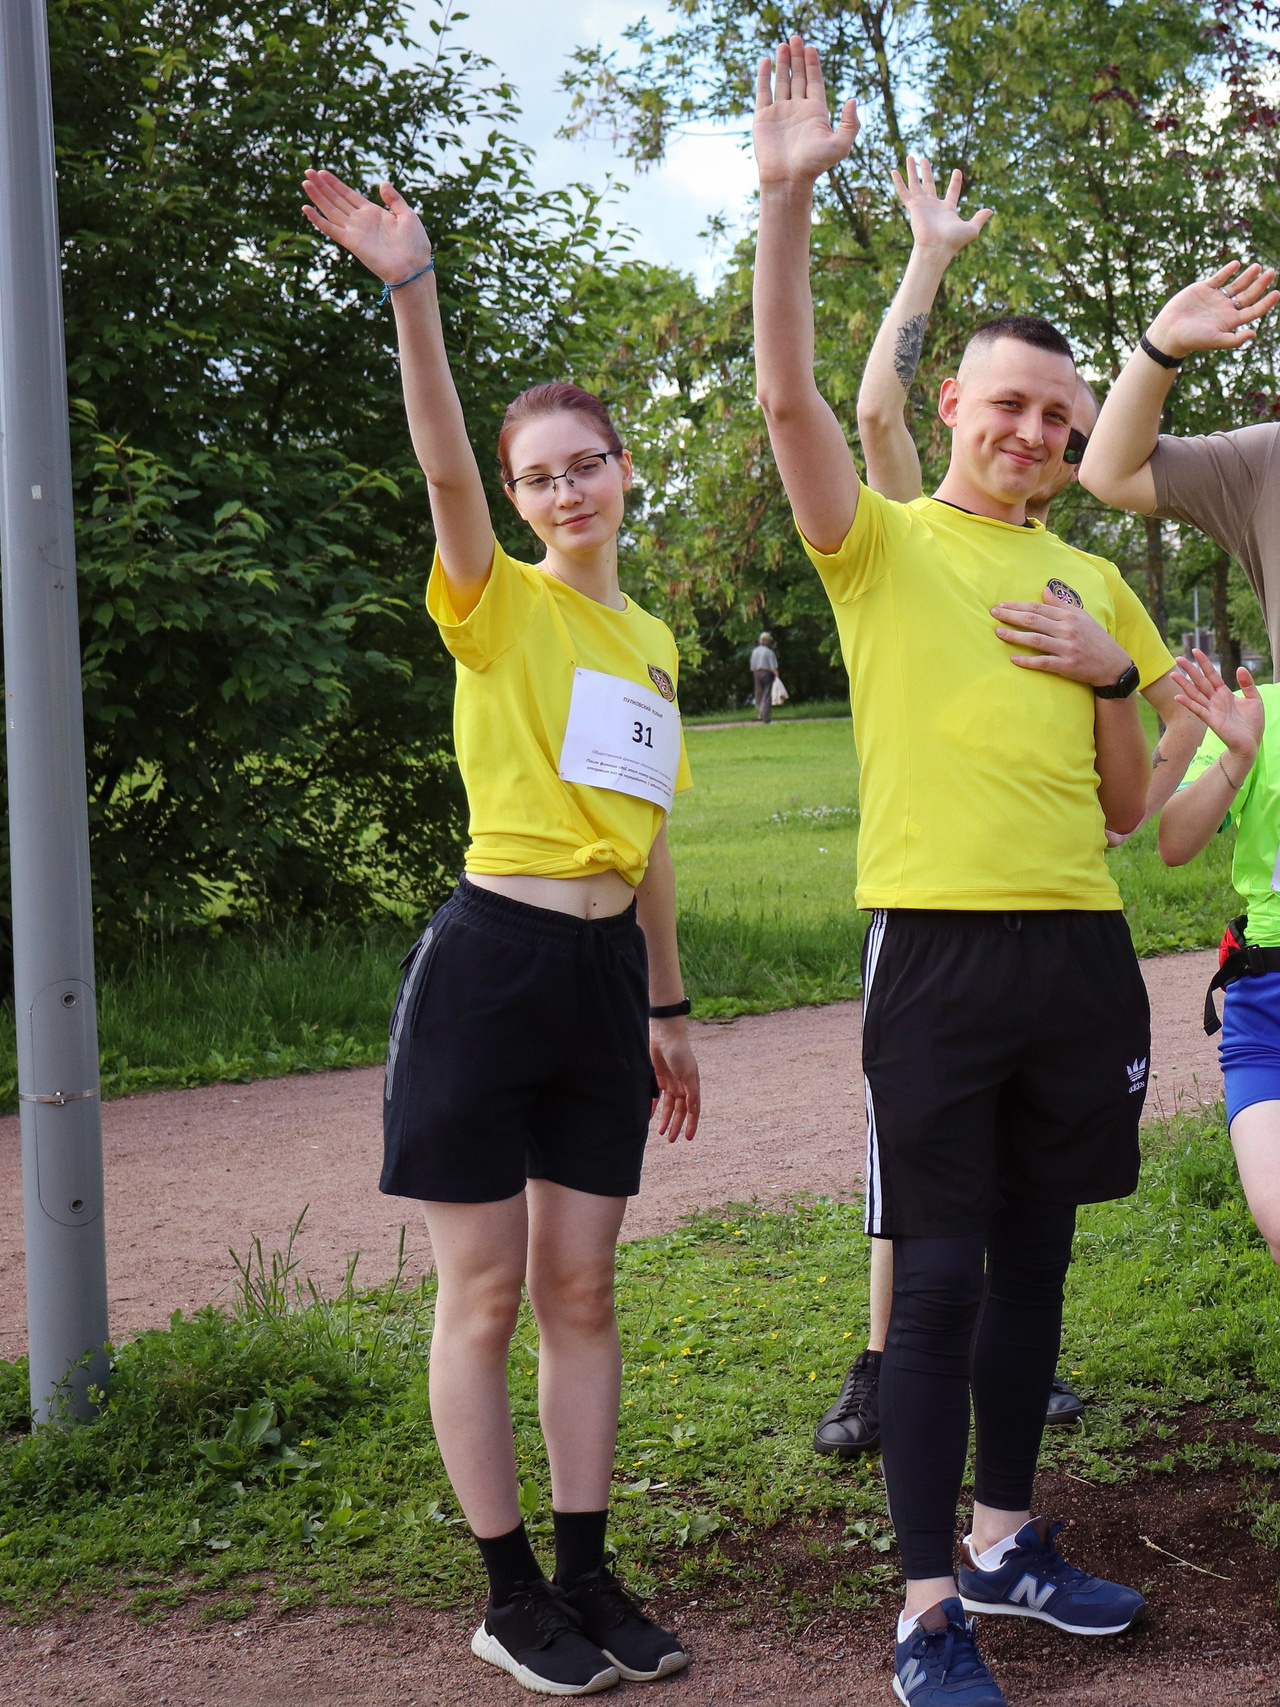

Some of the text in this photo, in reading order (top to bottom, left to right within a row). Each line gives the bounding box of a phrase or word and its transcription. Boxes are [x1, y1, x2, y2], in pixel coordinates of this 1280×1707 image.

[623, 696, 651, 713] ПУЛКОВСКИЙ
[631, 721, 654, 749] 31
[1128, 1081, 1145, 1094] adidas
[1009, 1572, 1058, 1611] N
[899, 1658, 927, 1697] N
